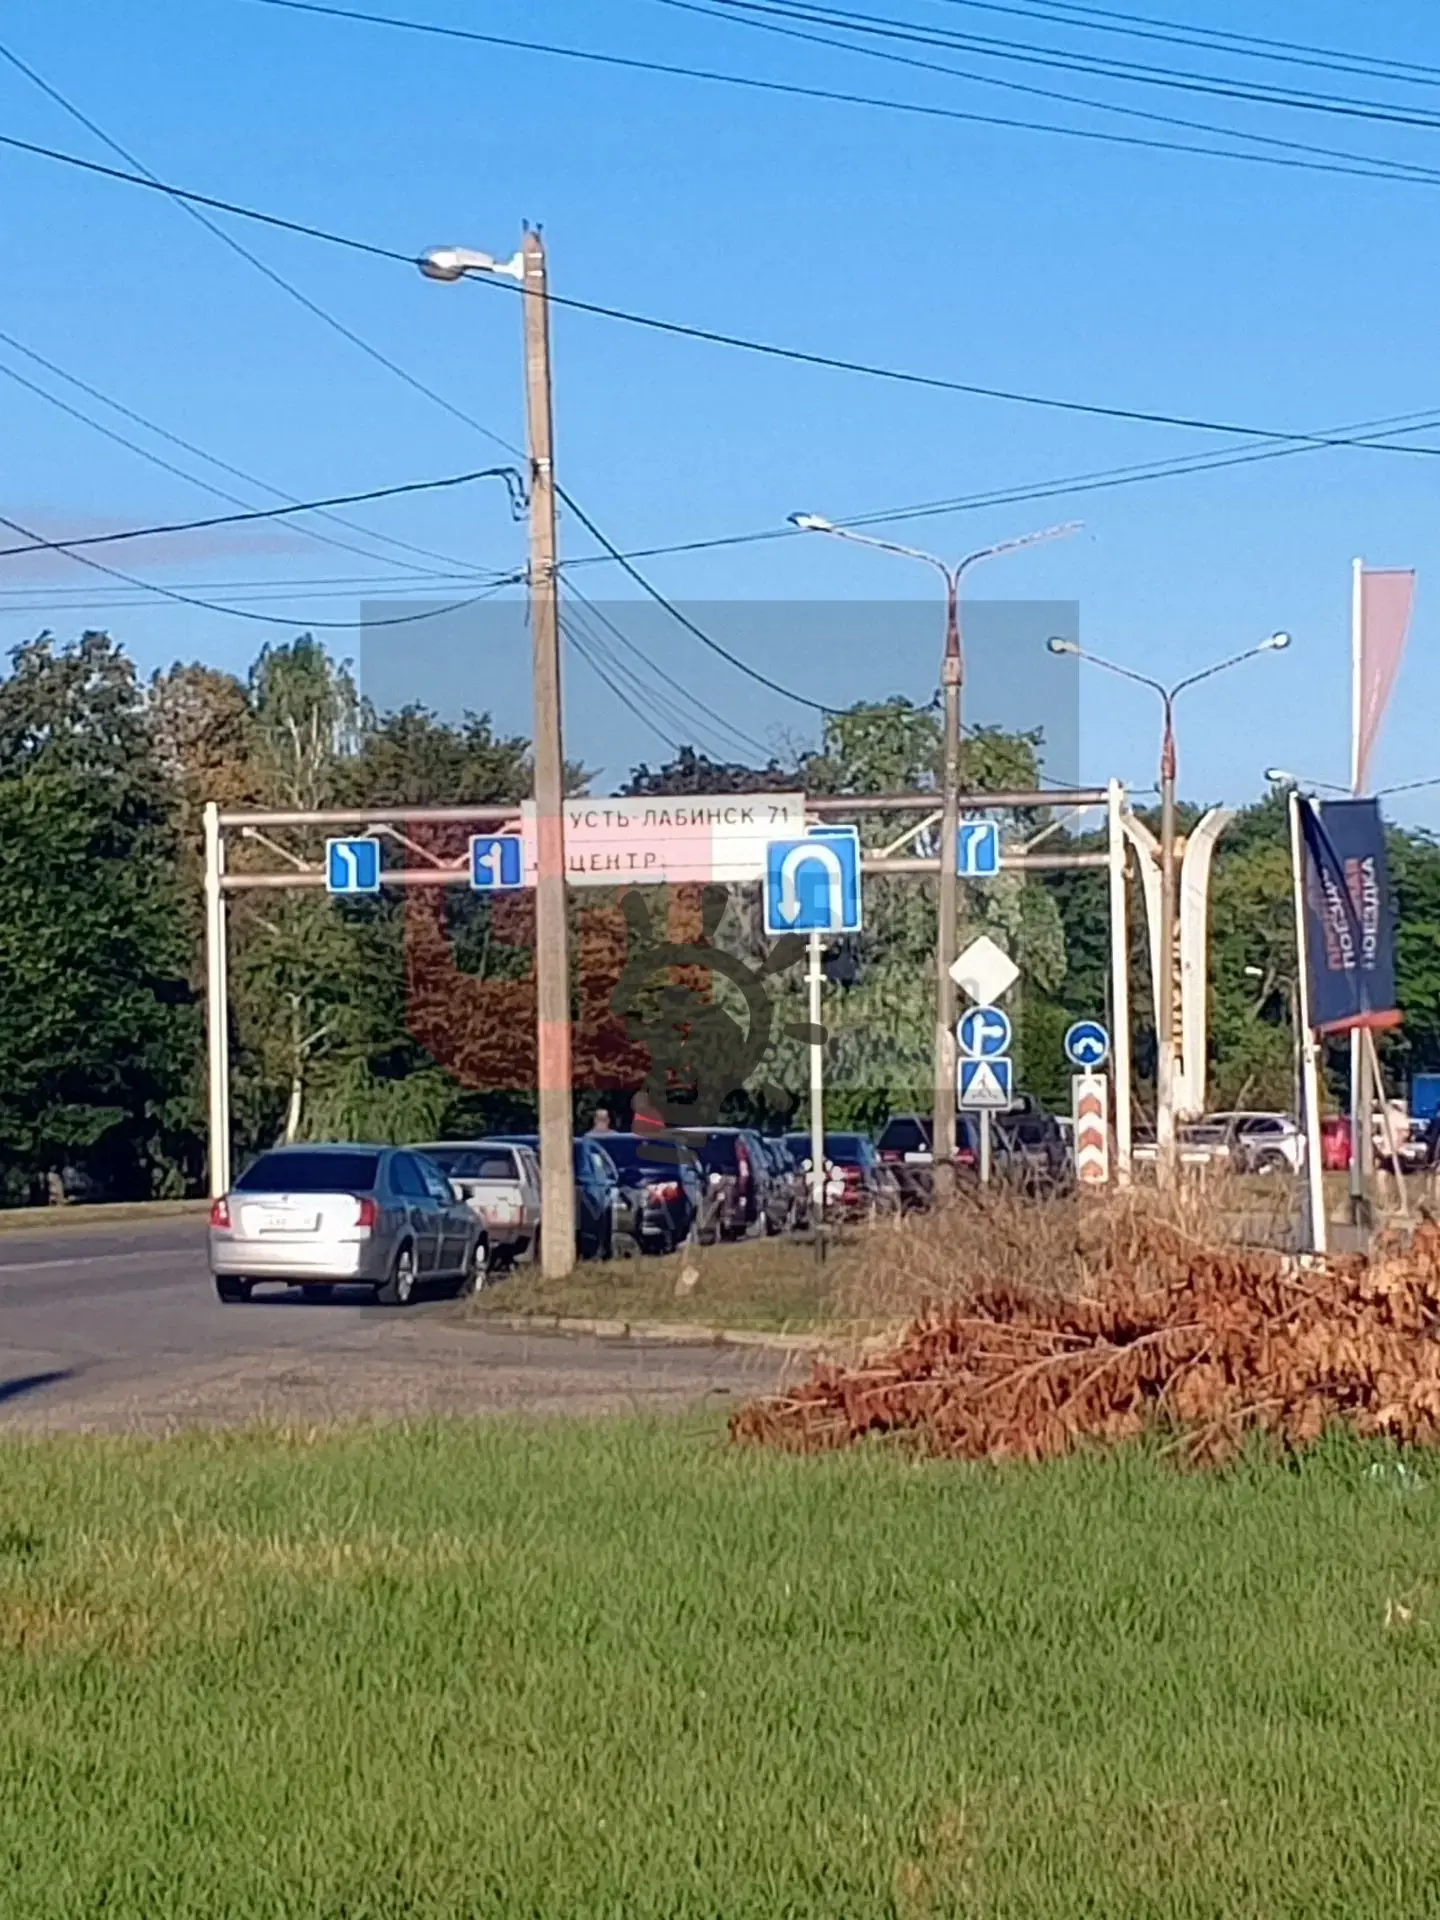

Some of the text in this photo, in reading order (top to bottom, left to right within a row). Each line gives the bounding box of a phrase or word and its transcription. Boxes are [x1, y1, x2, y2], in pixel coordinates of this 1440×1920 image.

[570, 805, 789, 829] УСТЬ-ЛАБИНСК 71
[569, 852, 657, 873] ЦЕНТР
